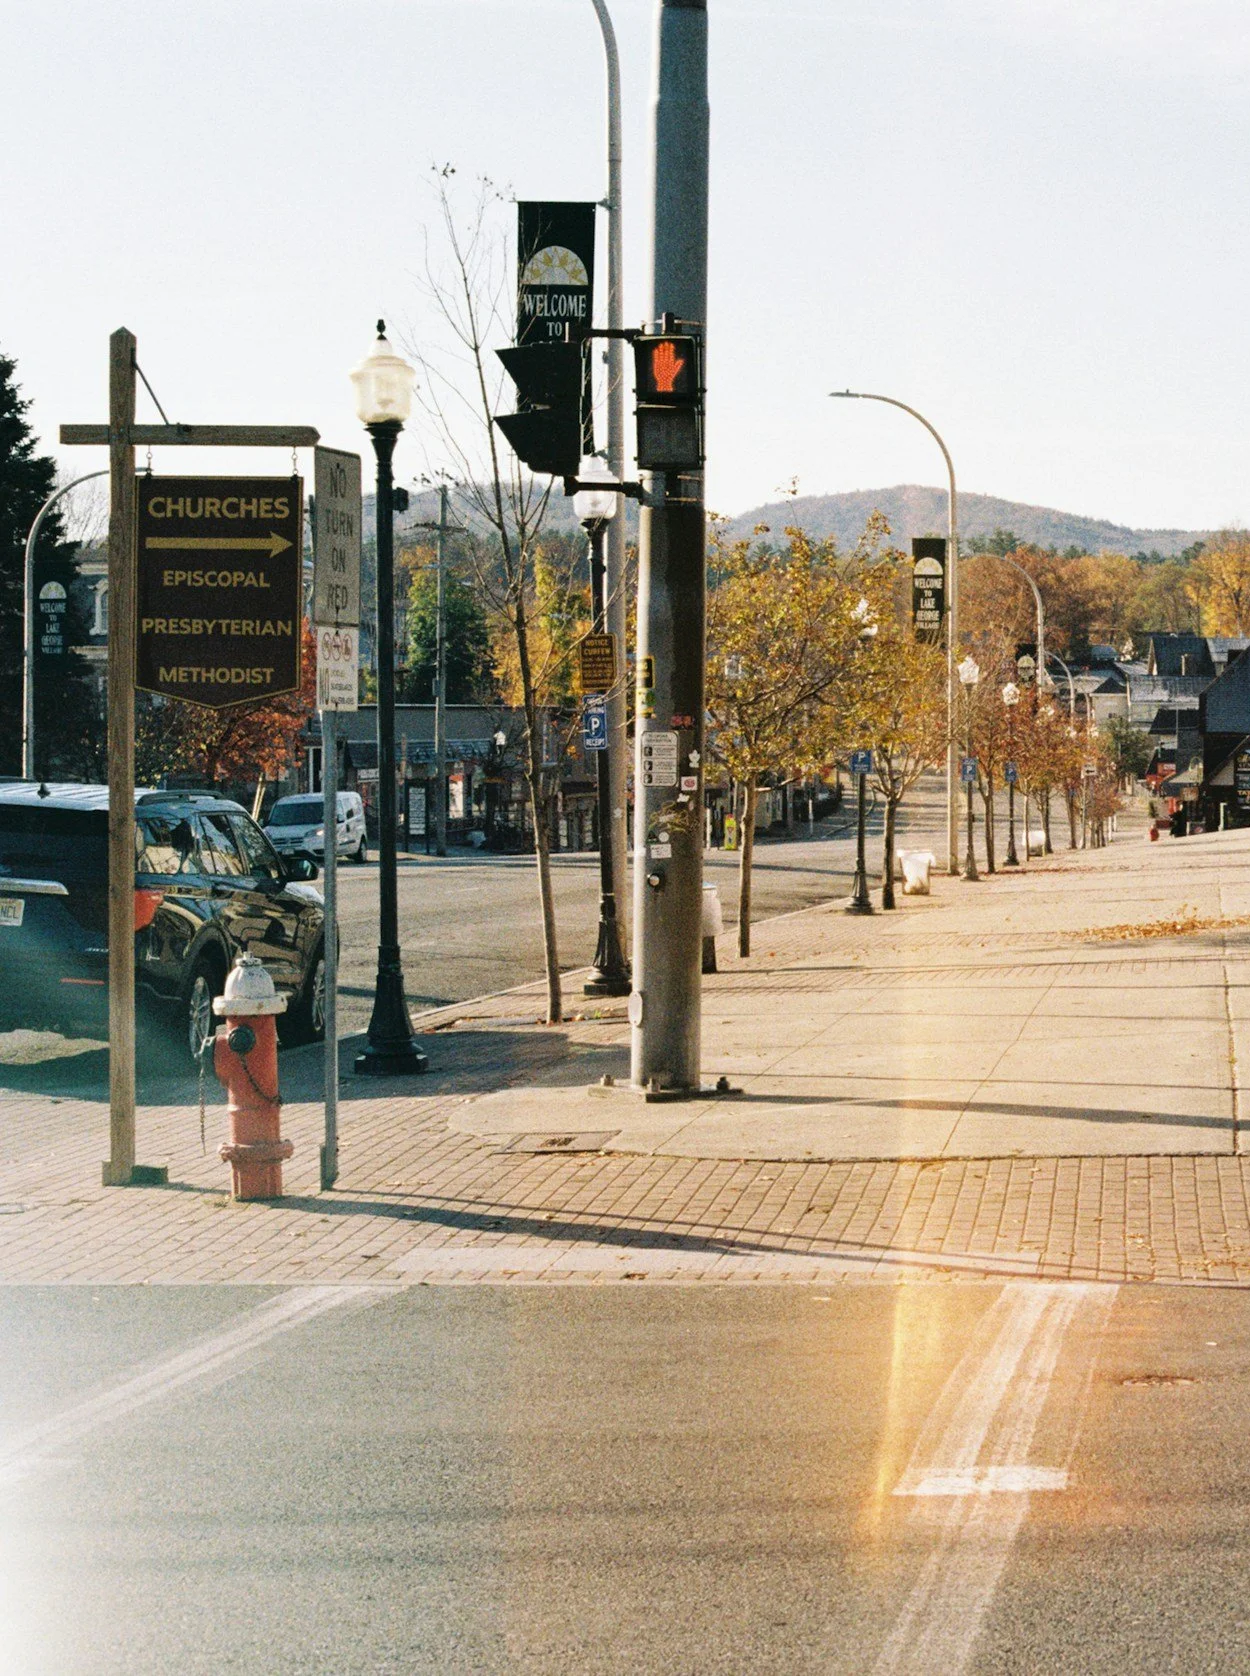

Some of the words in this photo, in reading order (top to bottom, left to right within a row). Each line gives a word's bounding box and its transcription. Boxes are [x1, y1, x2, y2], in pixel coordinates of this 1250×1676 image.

[523, 294, 587, 317] WELCOME
[546, 321, 563, 337] TO
[330, 467, 347, 498] NO
[148, 496, 290, 519] CHURCHES
[326, 508, 354, 537] TURN
[331, 547, 346, 573] ON
[163, 569, 270, 588] EPISCOPAL
[914, 577, 943, 589] WELCOME
[327, 584, 348, 610] RED
[920, 598, 936, 609] LAKE
[141, 617, 292, 637] PRESBYTERIAN
[159, 666, 274, 684] METHODIST
